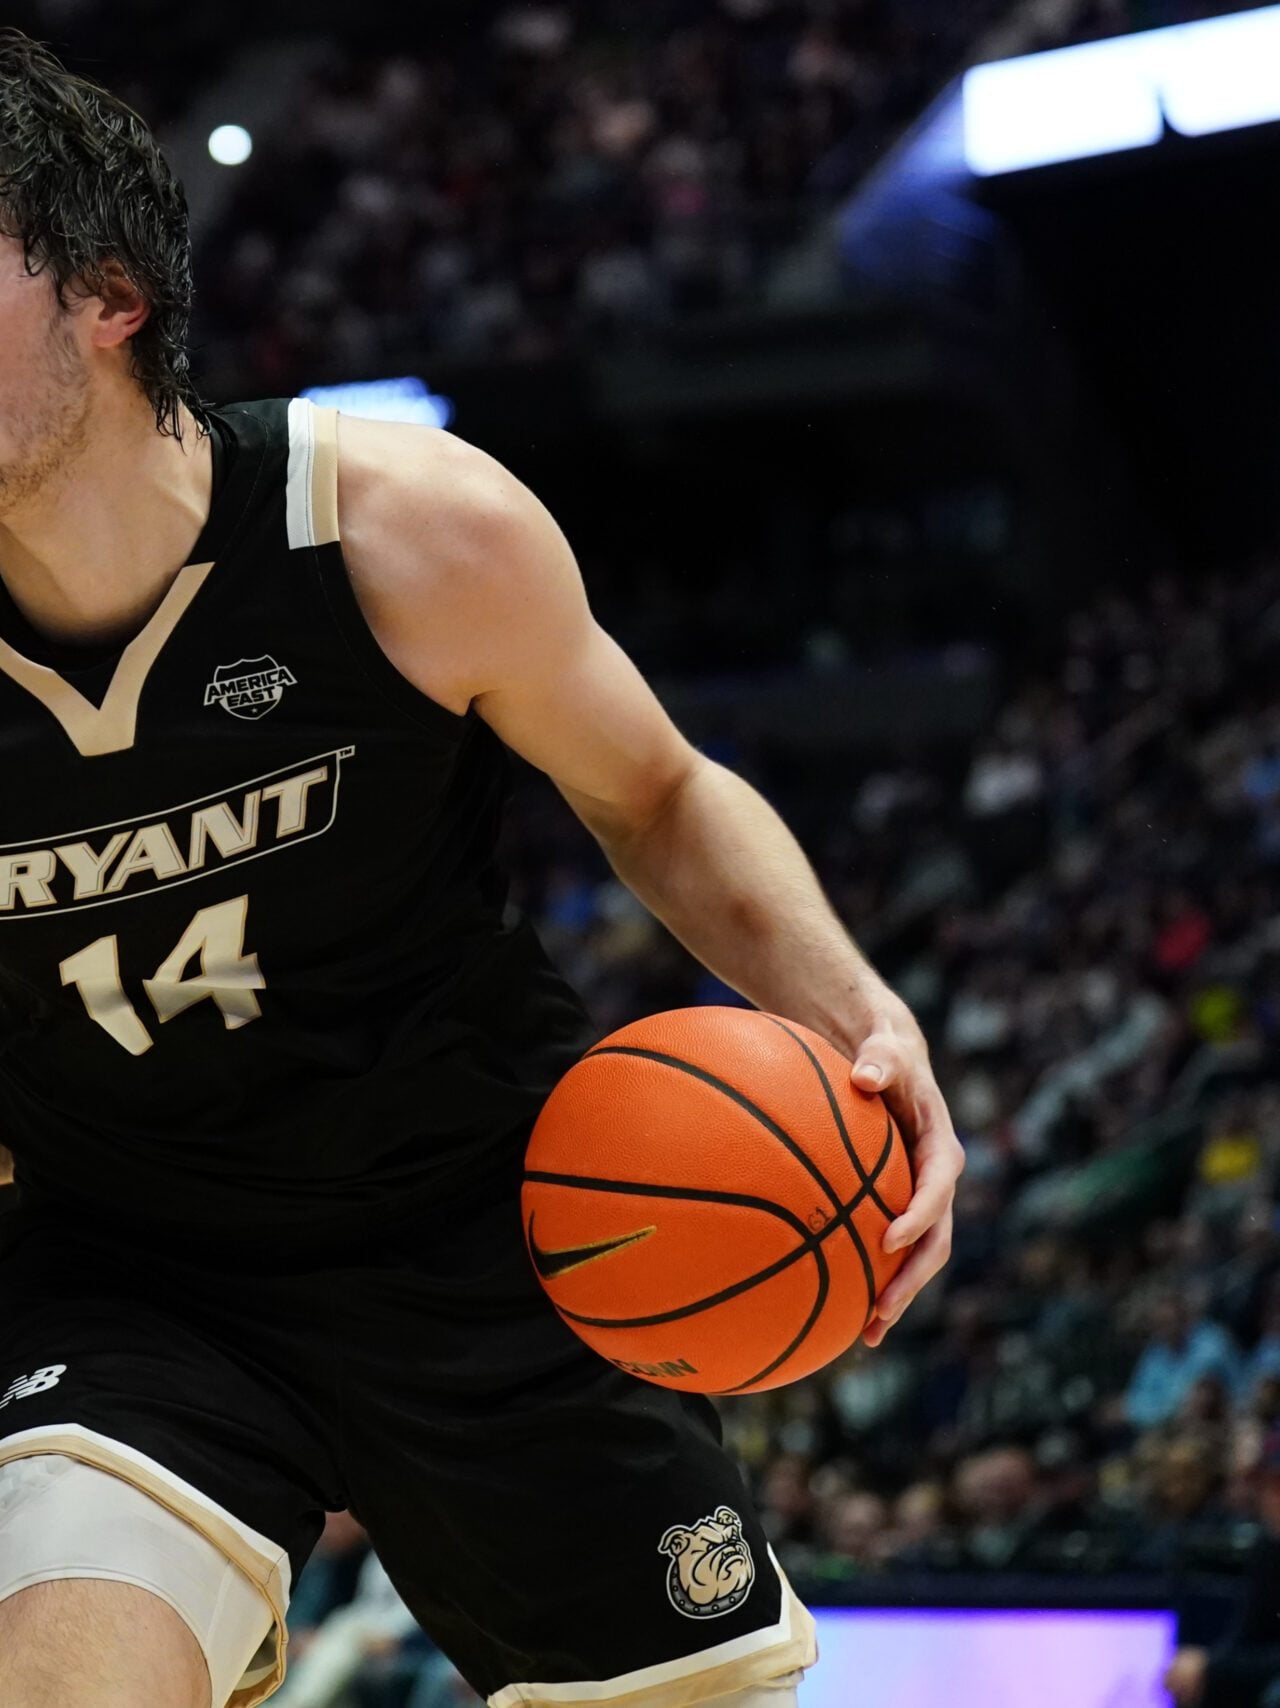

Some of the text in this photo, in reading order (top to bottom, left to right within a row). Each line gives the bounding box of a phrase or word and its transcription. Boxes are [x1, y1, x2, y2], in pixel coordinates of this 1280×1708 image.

[206, 668, 295, 703] AMERICA
[226, 686, 276, 707] EAST
[58, 894, 267, 1057] 14
